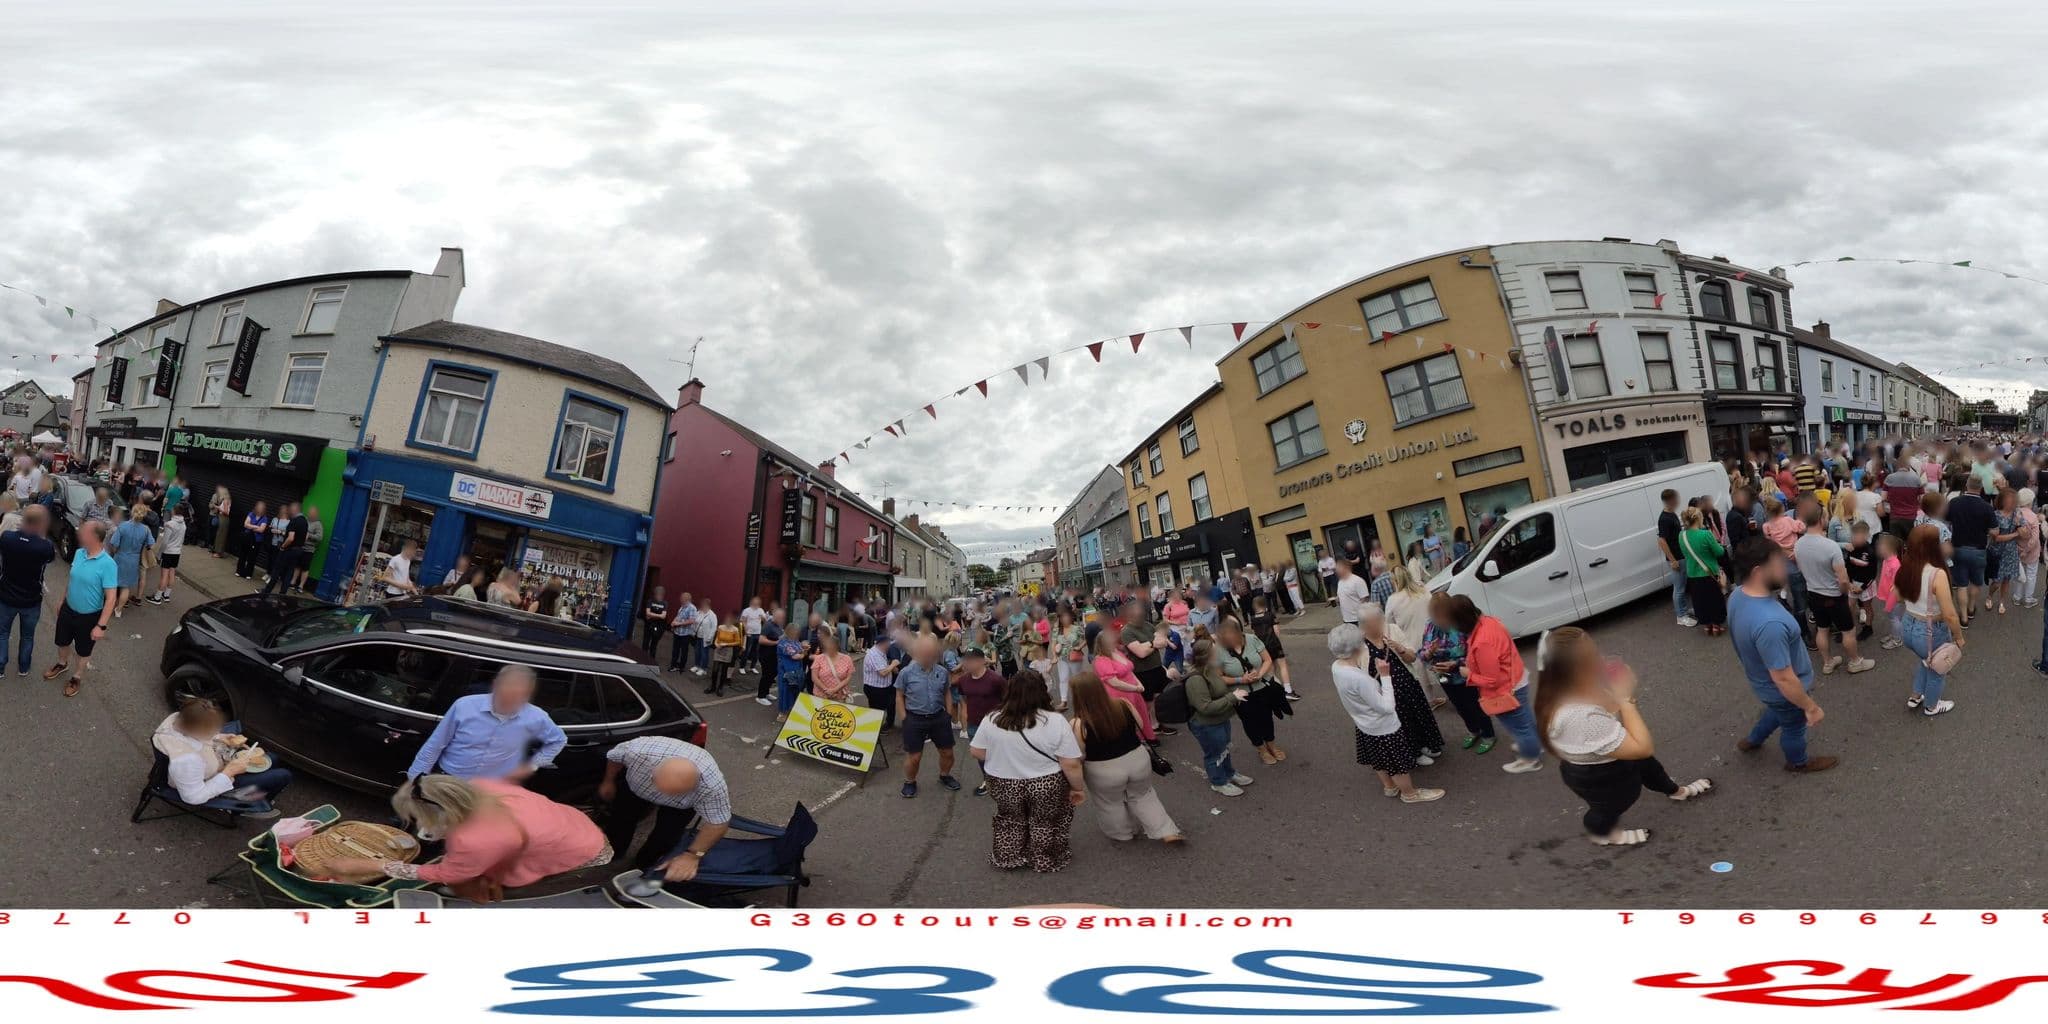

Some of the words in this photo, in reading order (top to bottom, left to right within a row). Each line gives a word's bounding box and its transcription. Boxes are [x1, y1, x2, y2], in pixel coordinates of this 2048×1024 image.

[1554, 414, 1626, 438] TOALS
[1636, 413, 1697, 426] bookmakers
[173, 432, 192, 446] Mc
[193, 432, 272, 457] Dermott's
[222, 452, 269, 466] PHARMACY
[1279, 471, 1333, 498] Dromore
[1336, 451, 1384, 478] Credit
[1386, 439, 1438, 463] Union
[1442, 425, 1478, 448] Ltd.
[458, 480, 476, 495] DC
[479, 483, 522, 507] MARVEL
[536, 562, 572, 577] FLEADH
[576, 568, 605, 581] ULADH
[815, 708, 843, 720] Back
[819, 718, 852, 729] Street
[823, 727, 845, 739] Eats
[826, 749, 842, 758] THIS
[843, 753, 861, 762] WAY
